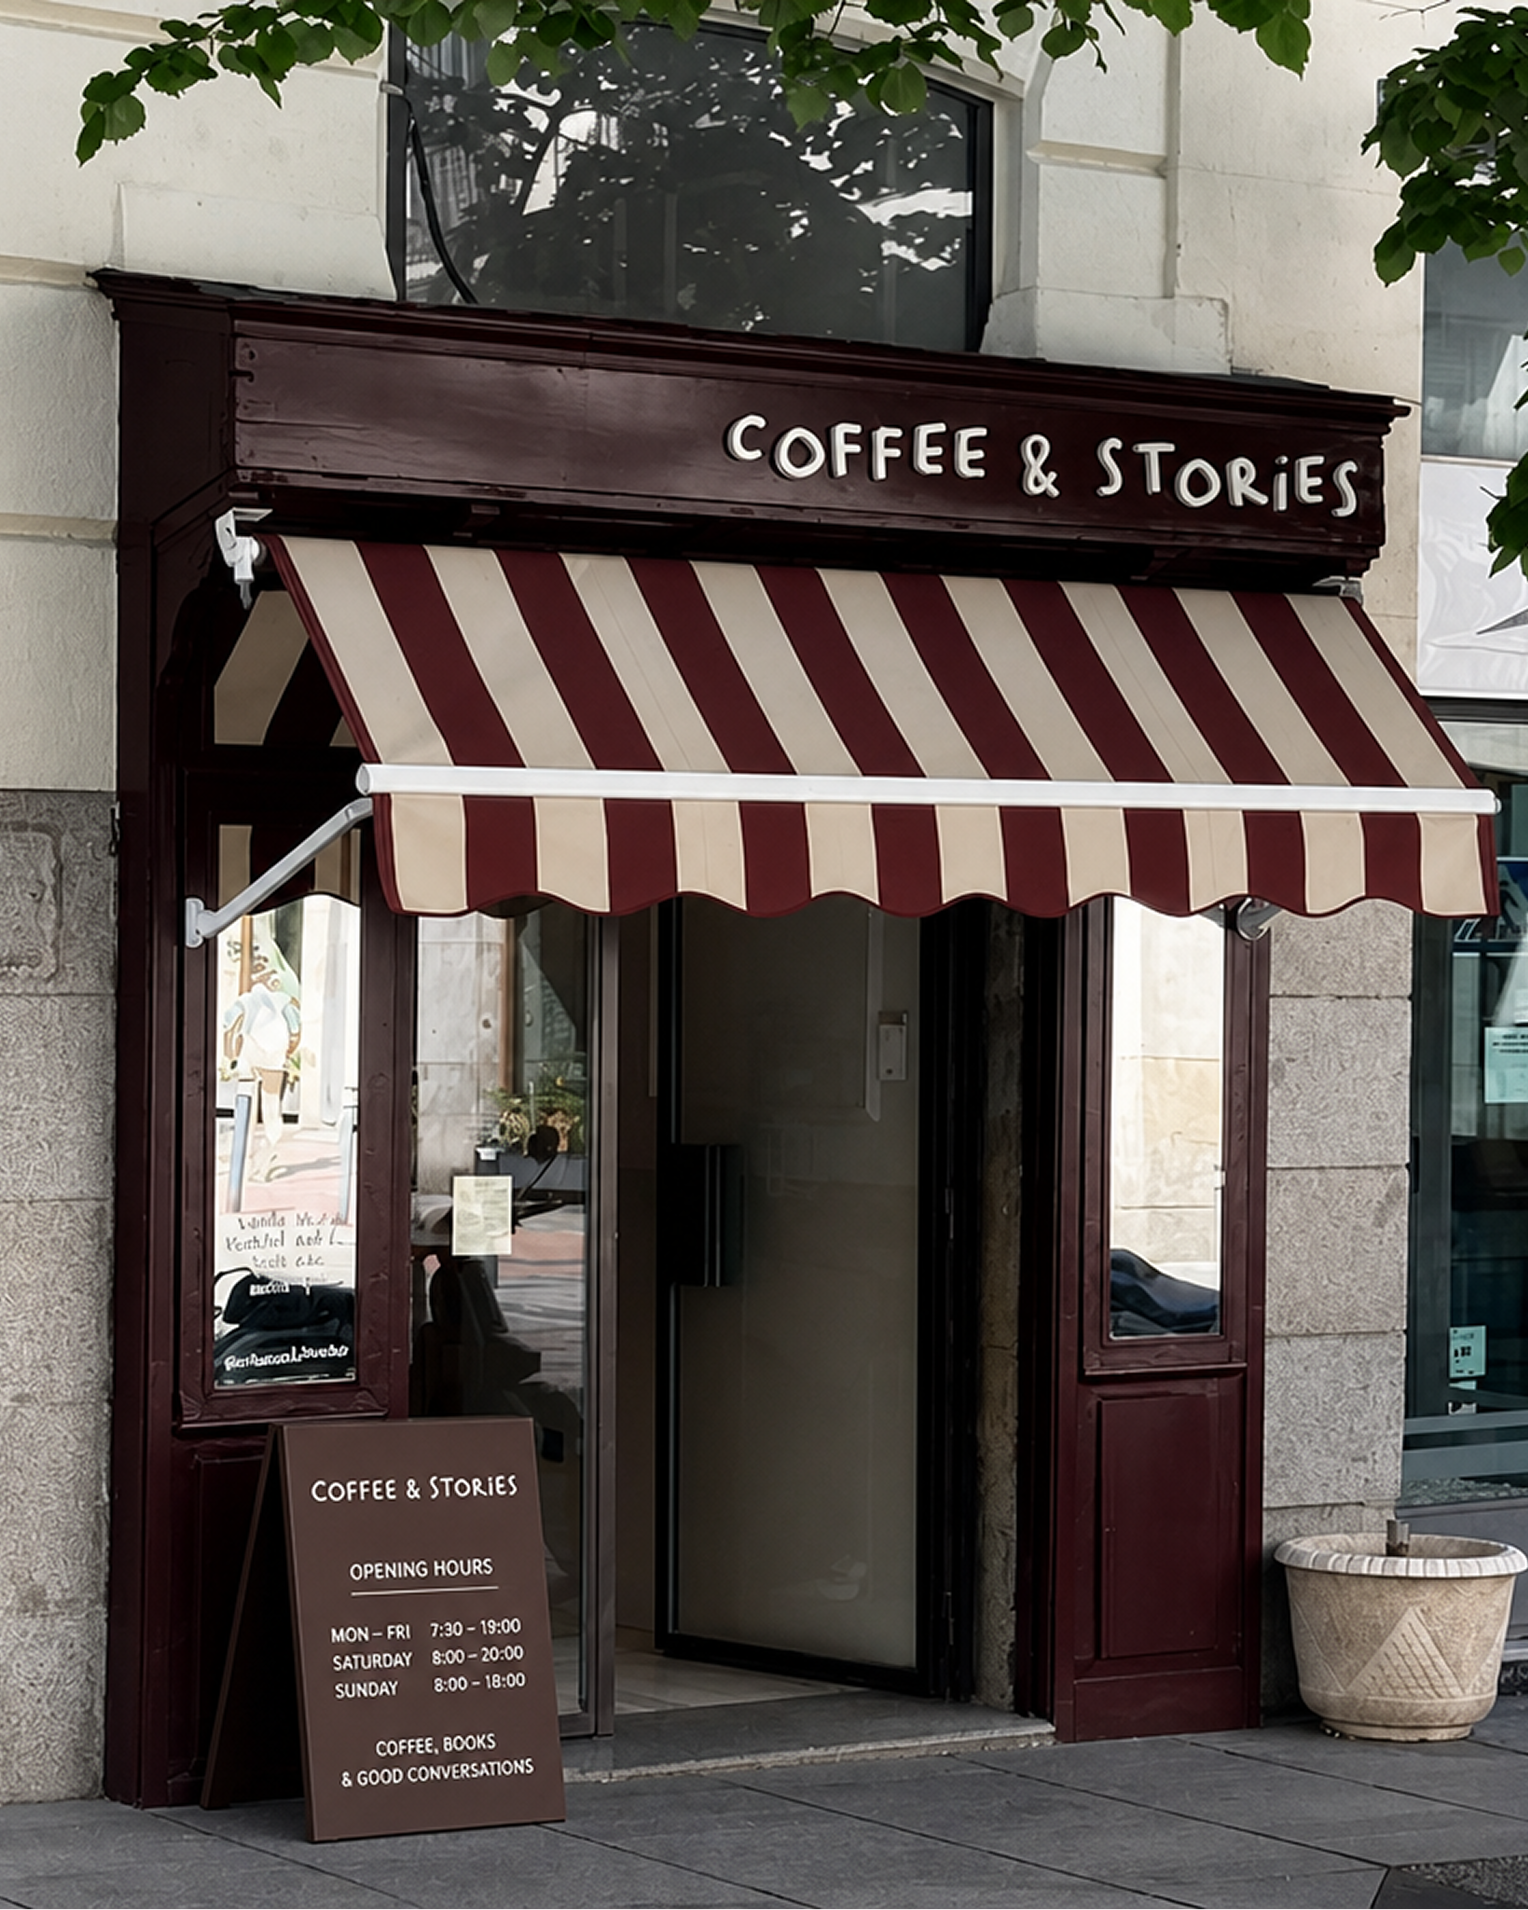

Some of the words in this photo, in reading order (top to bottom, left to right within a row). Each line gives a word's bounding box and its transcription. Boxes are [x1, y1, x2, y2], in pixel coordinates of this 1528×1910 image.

[728, 414, 988, 480] COFFEE
[1021, 434, 1060, 498] &
[311, 1479, 397, 1502] COFFEE
[406, 1478, 421, 1500] &
[349, 1560, 429, 1581] OPENING
[433, 1557, 493, 1577] HOURS
[331, 1626, 369, 1643] MON
[387, 1624, 411, 1640] FRI
[430, 1621, 463, 1637] 7:30
[480, 1617, 521, 1635] 19:00
[332, 1651, 413, 1672] SATURDAY
[432, 1649, 465, 1666] 8:00
[481, 1645, 524, 1662] 20:00
[334, 1680, 399, 1699] SUNDAY
[434, 1676, 468, 1693] 8:00
[485, 1672, 526, 1689] 18:00
[375, 1737, 439, 1757] COFFEE,
[443, 1733, 496, 1752] BOOKS
[341, 1771, 353, 1788] &
[356, 1767, 404, 1787] GOOD
[407, 1757, 534, 1783] CONVERSATIONS
